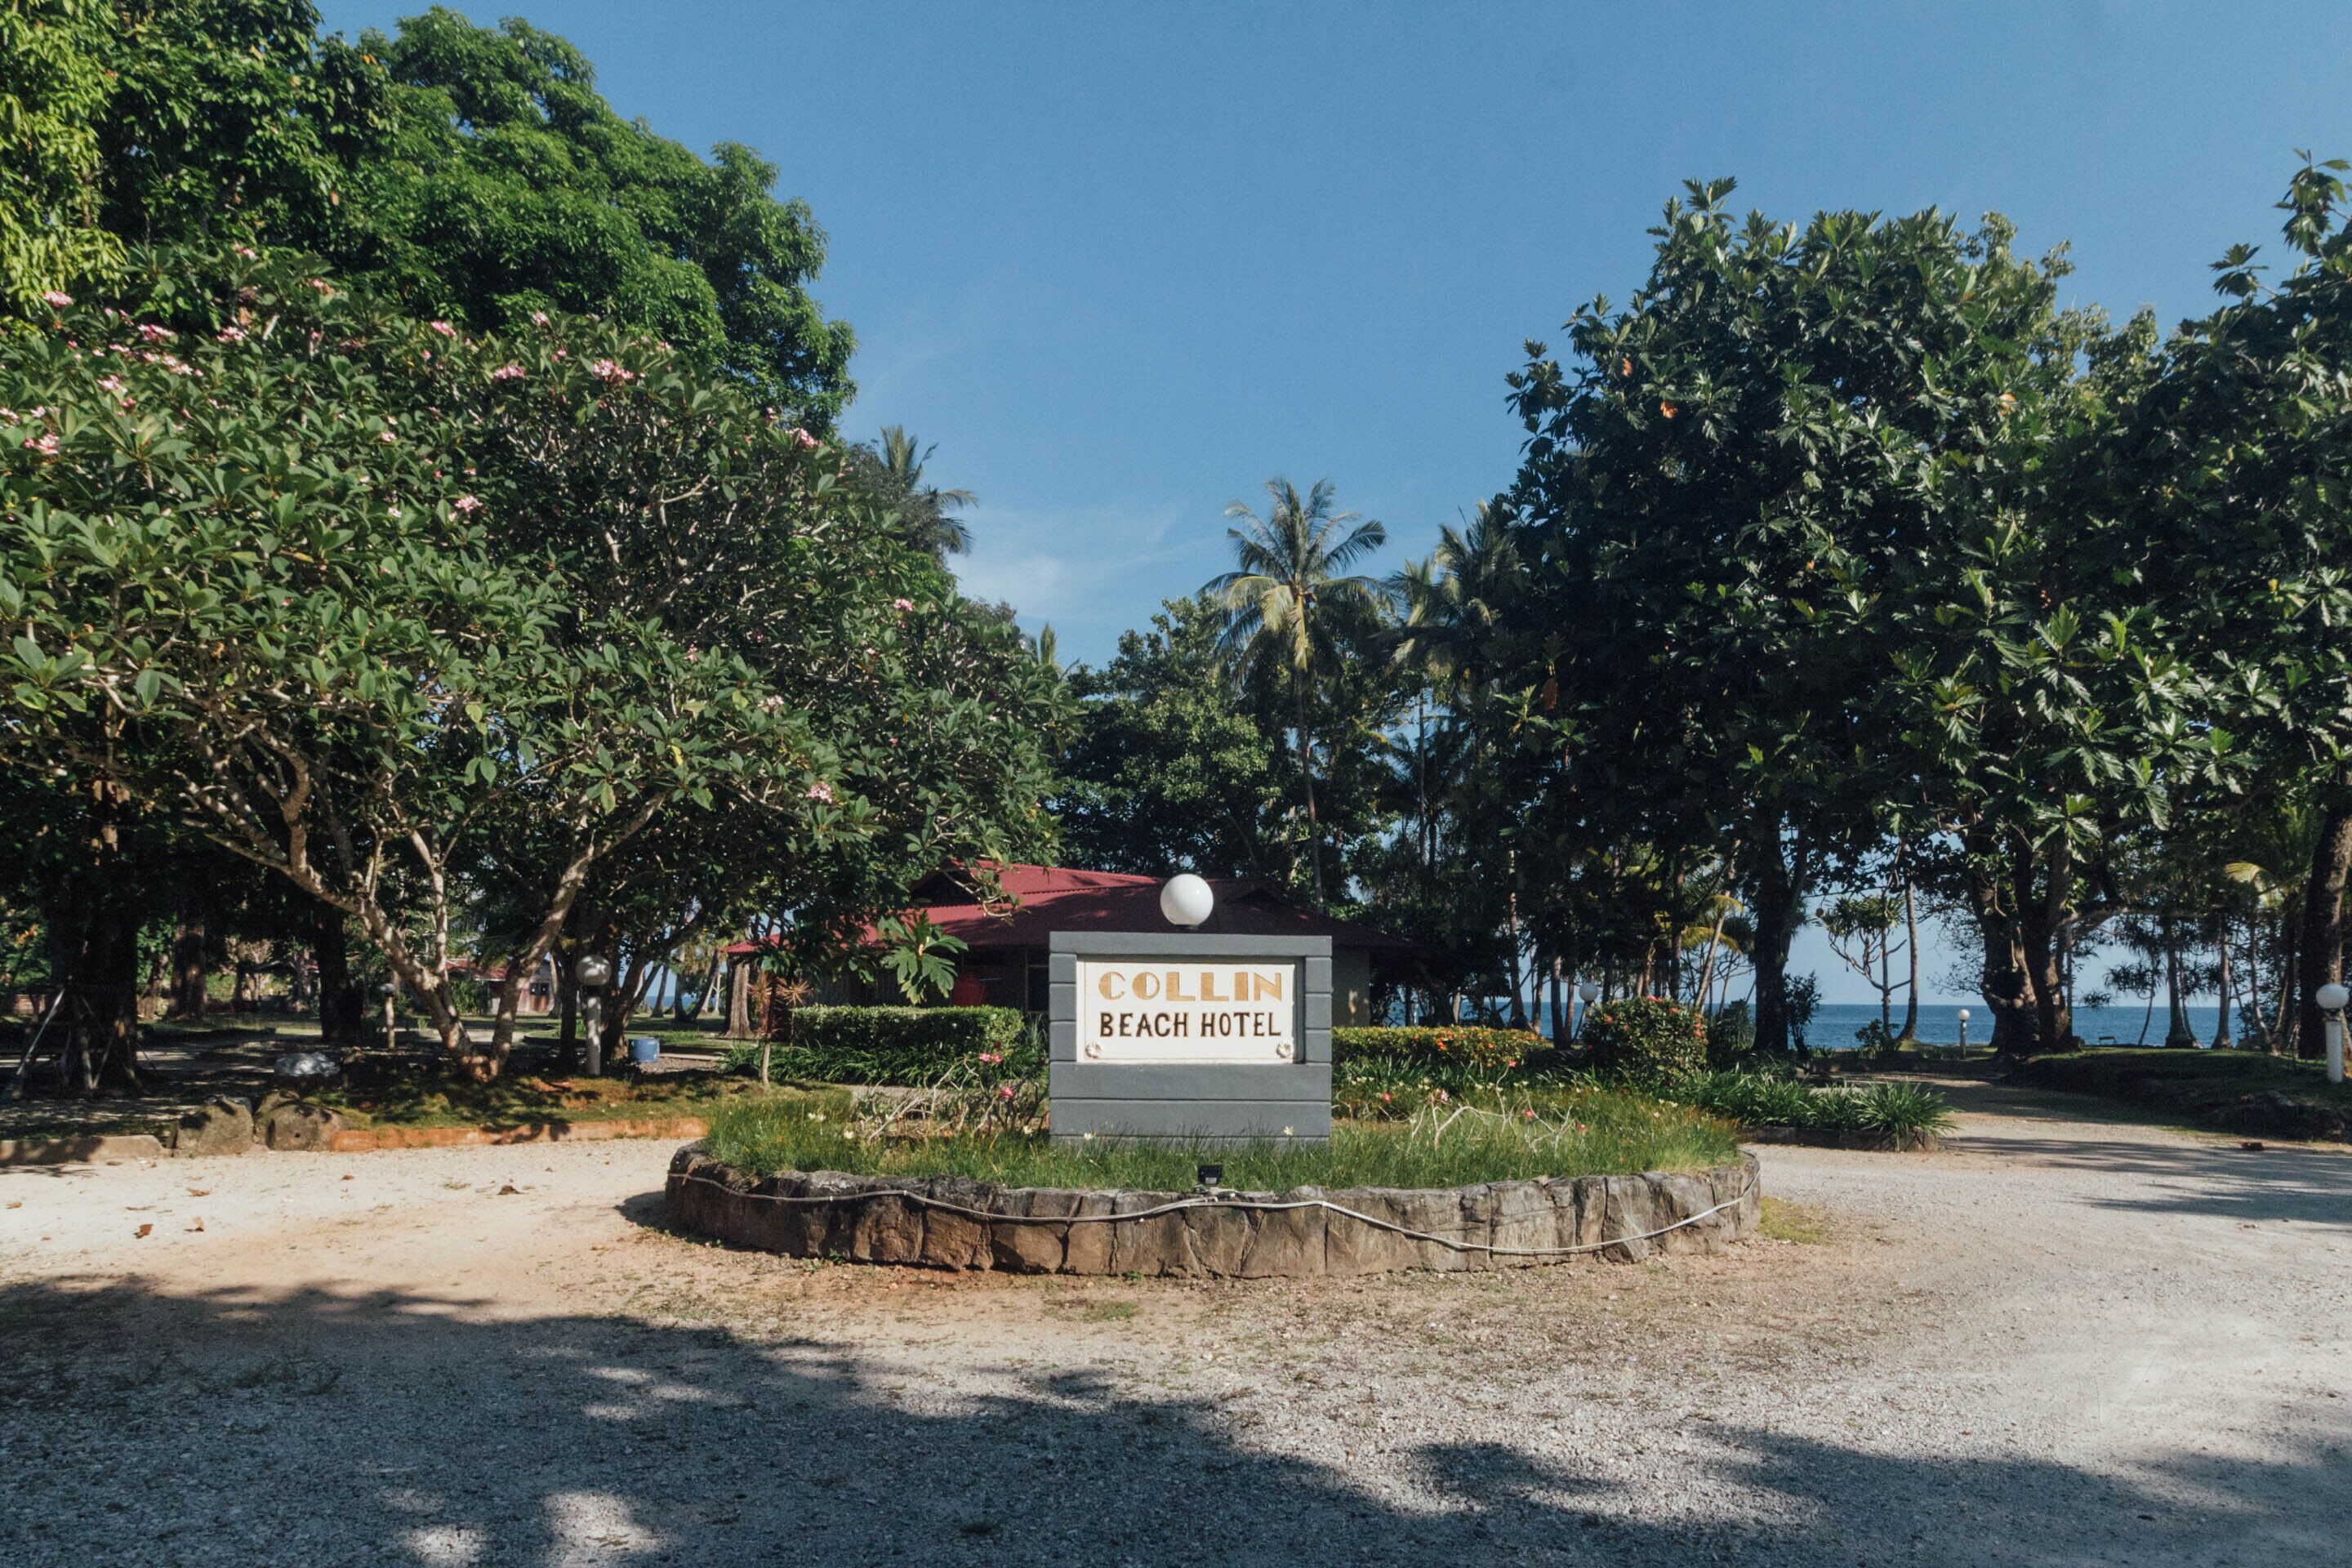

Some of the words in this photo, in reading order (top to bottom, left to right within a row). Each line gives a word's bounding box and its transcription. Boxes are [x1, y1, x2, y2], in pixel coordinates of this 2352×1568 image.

[1098, 971, 1282, 1001] COLLIN
[1099, 1012, 1189, 1037] BEACH
[1200, 1012, 1281, 1037] HOTEL
